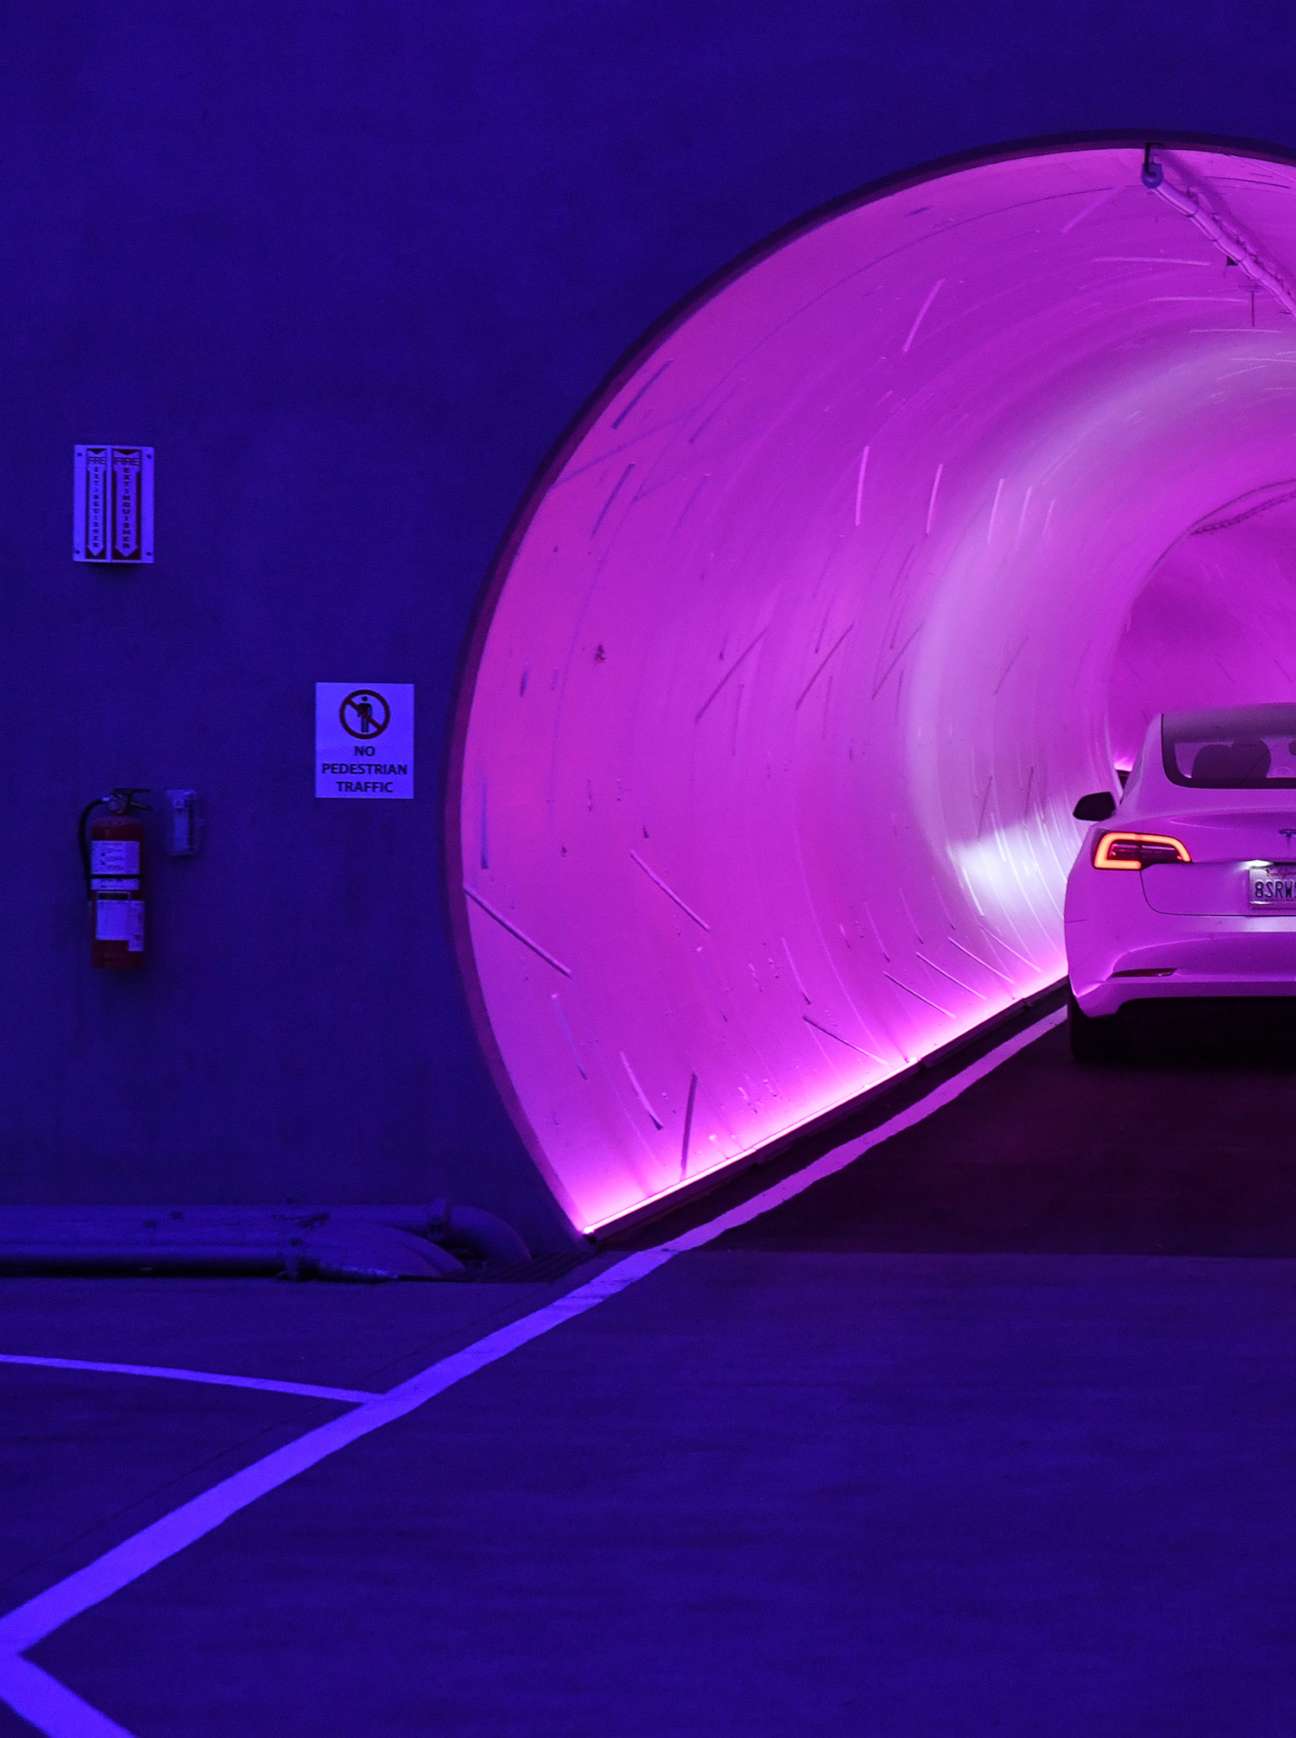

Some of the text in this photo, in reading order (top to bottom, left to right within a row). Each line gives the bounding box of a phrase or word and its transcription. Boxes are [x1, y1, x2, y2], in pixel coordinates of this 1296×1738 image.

[354, 746, 375, 757] NO
[322, 763, 408, 775] PEDESTRIAN
[336, 781, 393, 793] TRAFFIC
